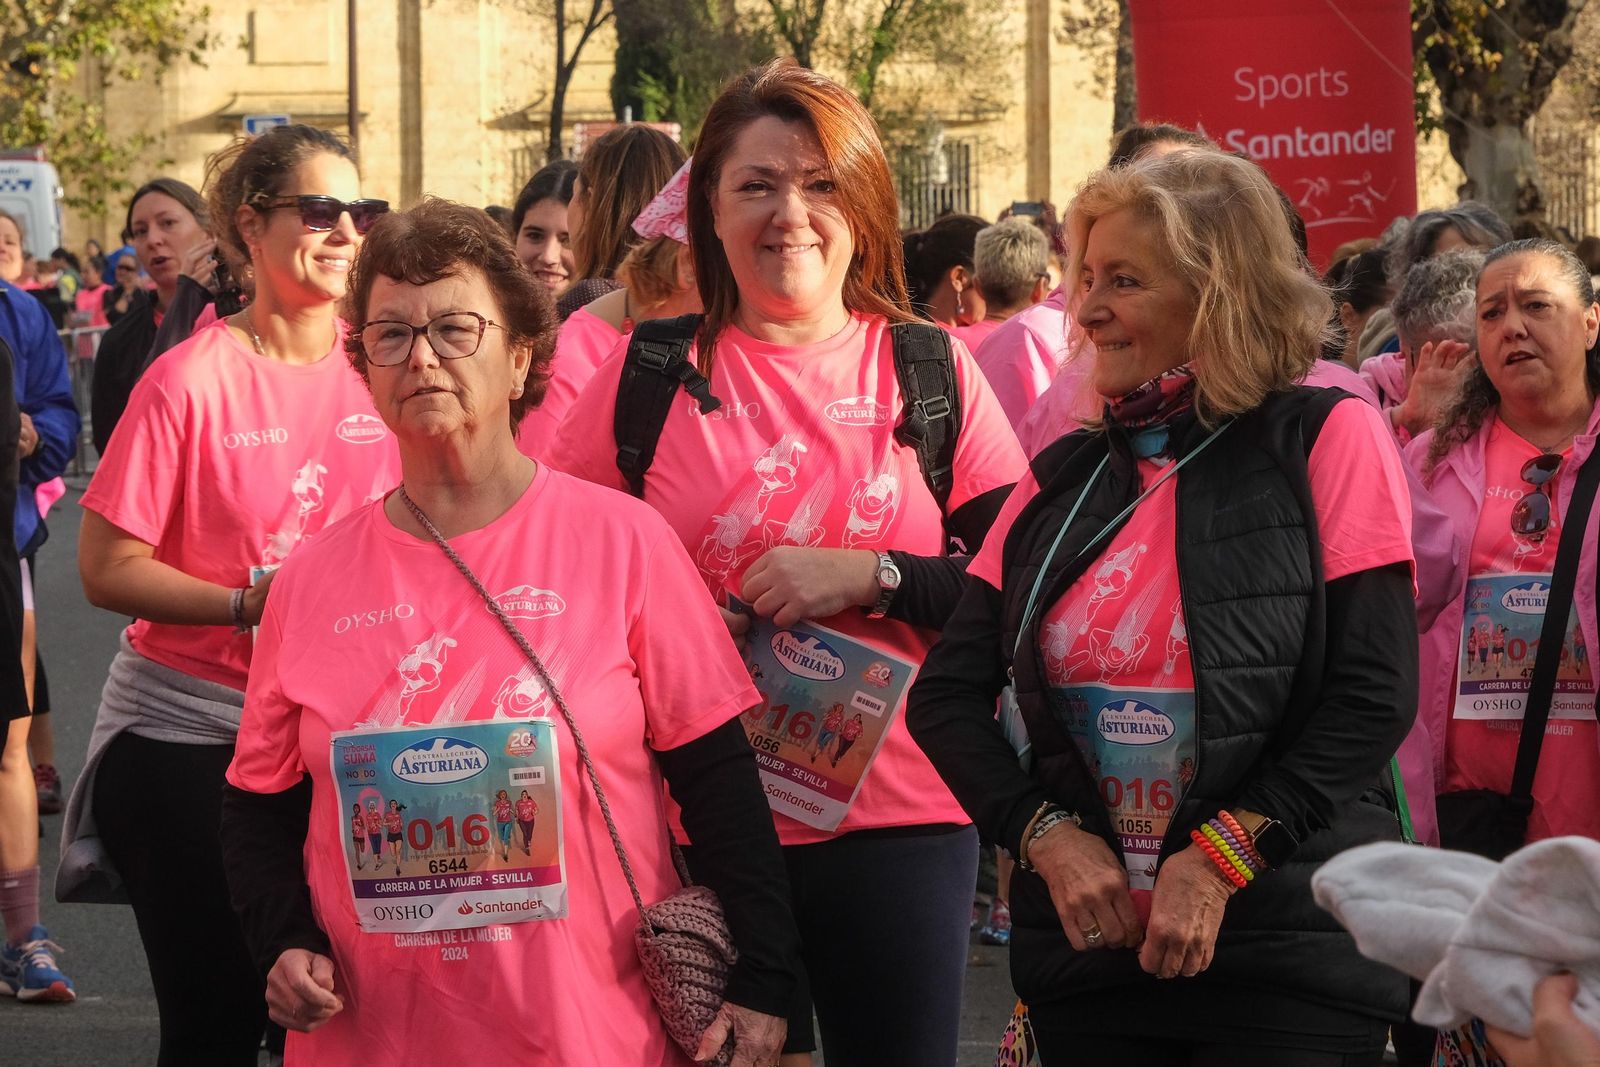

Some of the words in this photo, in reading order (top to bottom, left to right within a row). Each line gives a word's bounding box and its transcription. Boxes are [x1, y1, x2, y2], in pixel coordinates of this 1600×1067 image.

[1234, 66, 1349, 109] Sports
[1226, 122, 1395, 160] Santander
[224, 427, 289, 449] OYSHO
[1507, 594, 1546, 607] ASTURI
[334, 604, 414, 634] OYSHO
[773, 636, 837, 678] ASTURIANA
[868, 663, 891, 680] 20
[1480, 681, 1510, 691] CARRERA
[1512, 681, 1521, 689] DE
[1473, 699, 1522, 711] OYSHO
[1100, 714, 1169, 736] ASTURIANA
[511, 732, 531, 747] 20
[749, 731, 780, 754] 1056
[344, 752, 377, 765] SUMA
[412, 752, 443, 760] CENTRAL
[446, 750, 478, 758] LECHERA
[399, 757, 482, 775] ASTURIANA
[755, 753, 785, 772] MUJER
[791, 767, 828, 790] SEVILLA
[765, 783, 825, 816] Santander
[1101, 775, 1174, 811] 016
[407, 813, 490, 850] 016
[1119, 818, 1152, 834] 1055
[1122, 837, 1133, 848] LA
[1135, 838, 1163, 850] MUJE
[428, 857, 468, 874] 6544
[375, 881, 416, 893] CARRERA
[418, 880, 431, 890] DE
[434, 878, 447, 889] LA
[450, 875, 482, 888] MUJER
[492, 872, 533, 885] SEVILLA
[374, 904, 433, 921] OYSHO
[475, 899, 542, 914] Santander
[394, 931, 440, 947] CARRERA
[443, 930, 458, 944] DE
[461, 929, 475, 943] LA
[477, 927, 512, 942] MUJER
[441, 947, 468, 961] 2024
